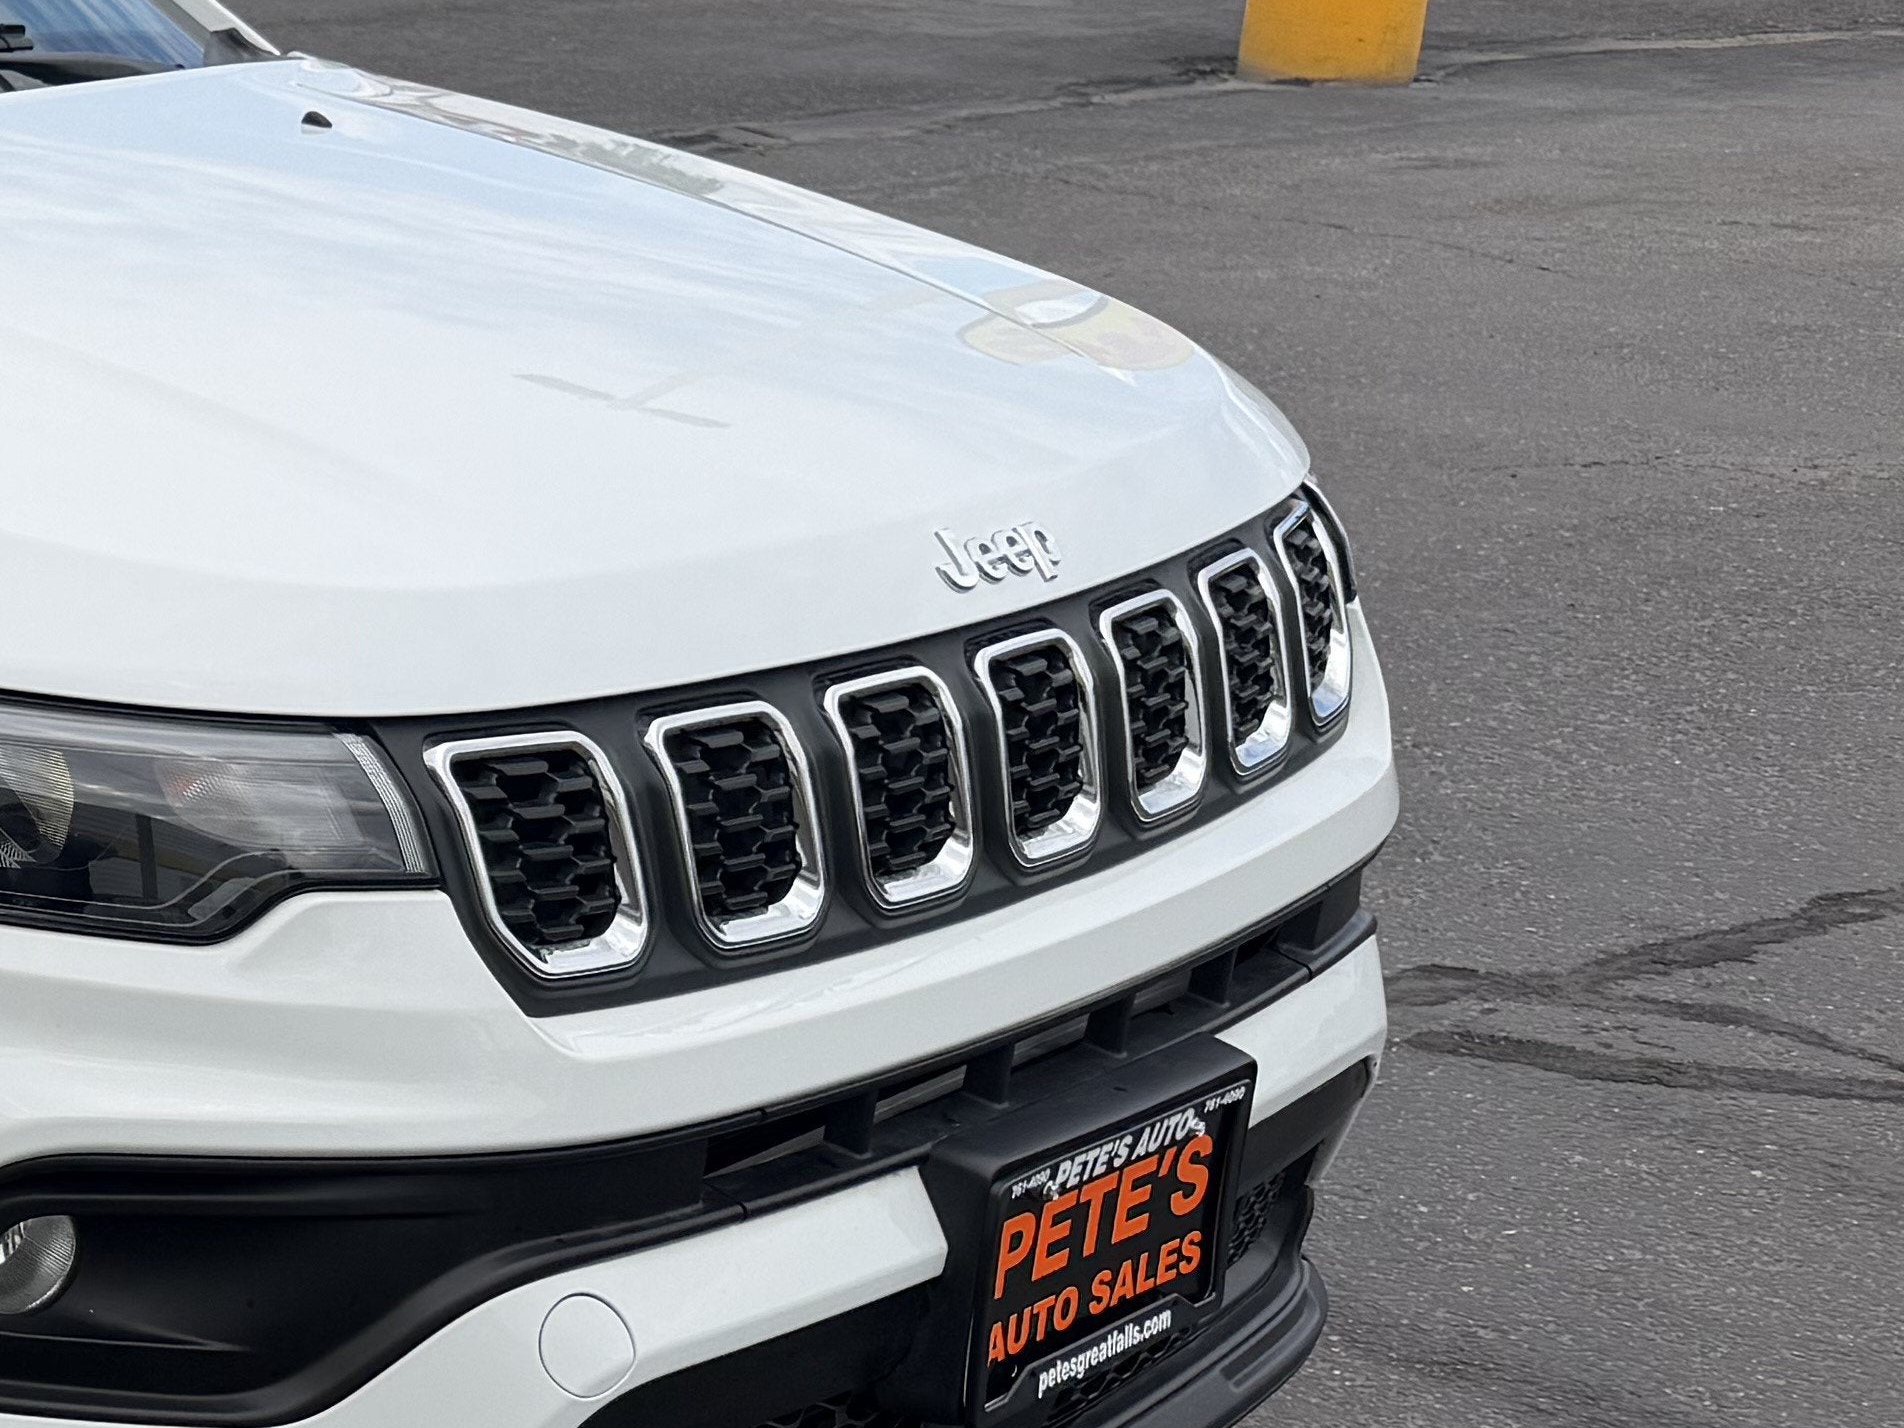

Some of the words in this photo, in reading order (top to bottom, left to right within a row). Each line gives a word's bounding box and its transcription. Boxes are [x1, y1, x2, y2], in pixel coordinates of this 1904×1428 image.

[933, 522, 1062, 594] Jeep
[1055, 1135, 1133, 1190] PETE'S
[1131, 1108, 1196, 1160] AUTO
[993, 1135, 1214, 1300] PETE'S
[988, 1286, 1079, 1367] AUTO
[1088, 1230, 1202, 1315] SALES
[1037, 1309, 1172, 1399] petesgreatfalls.com
